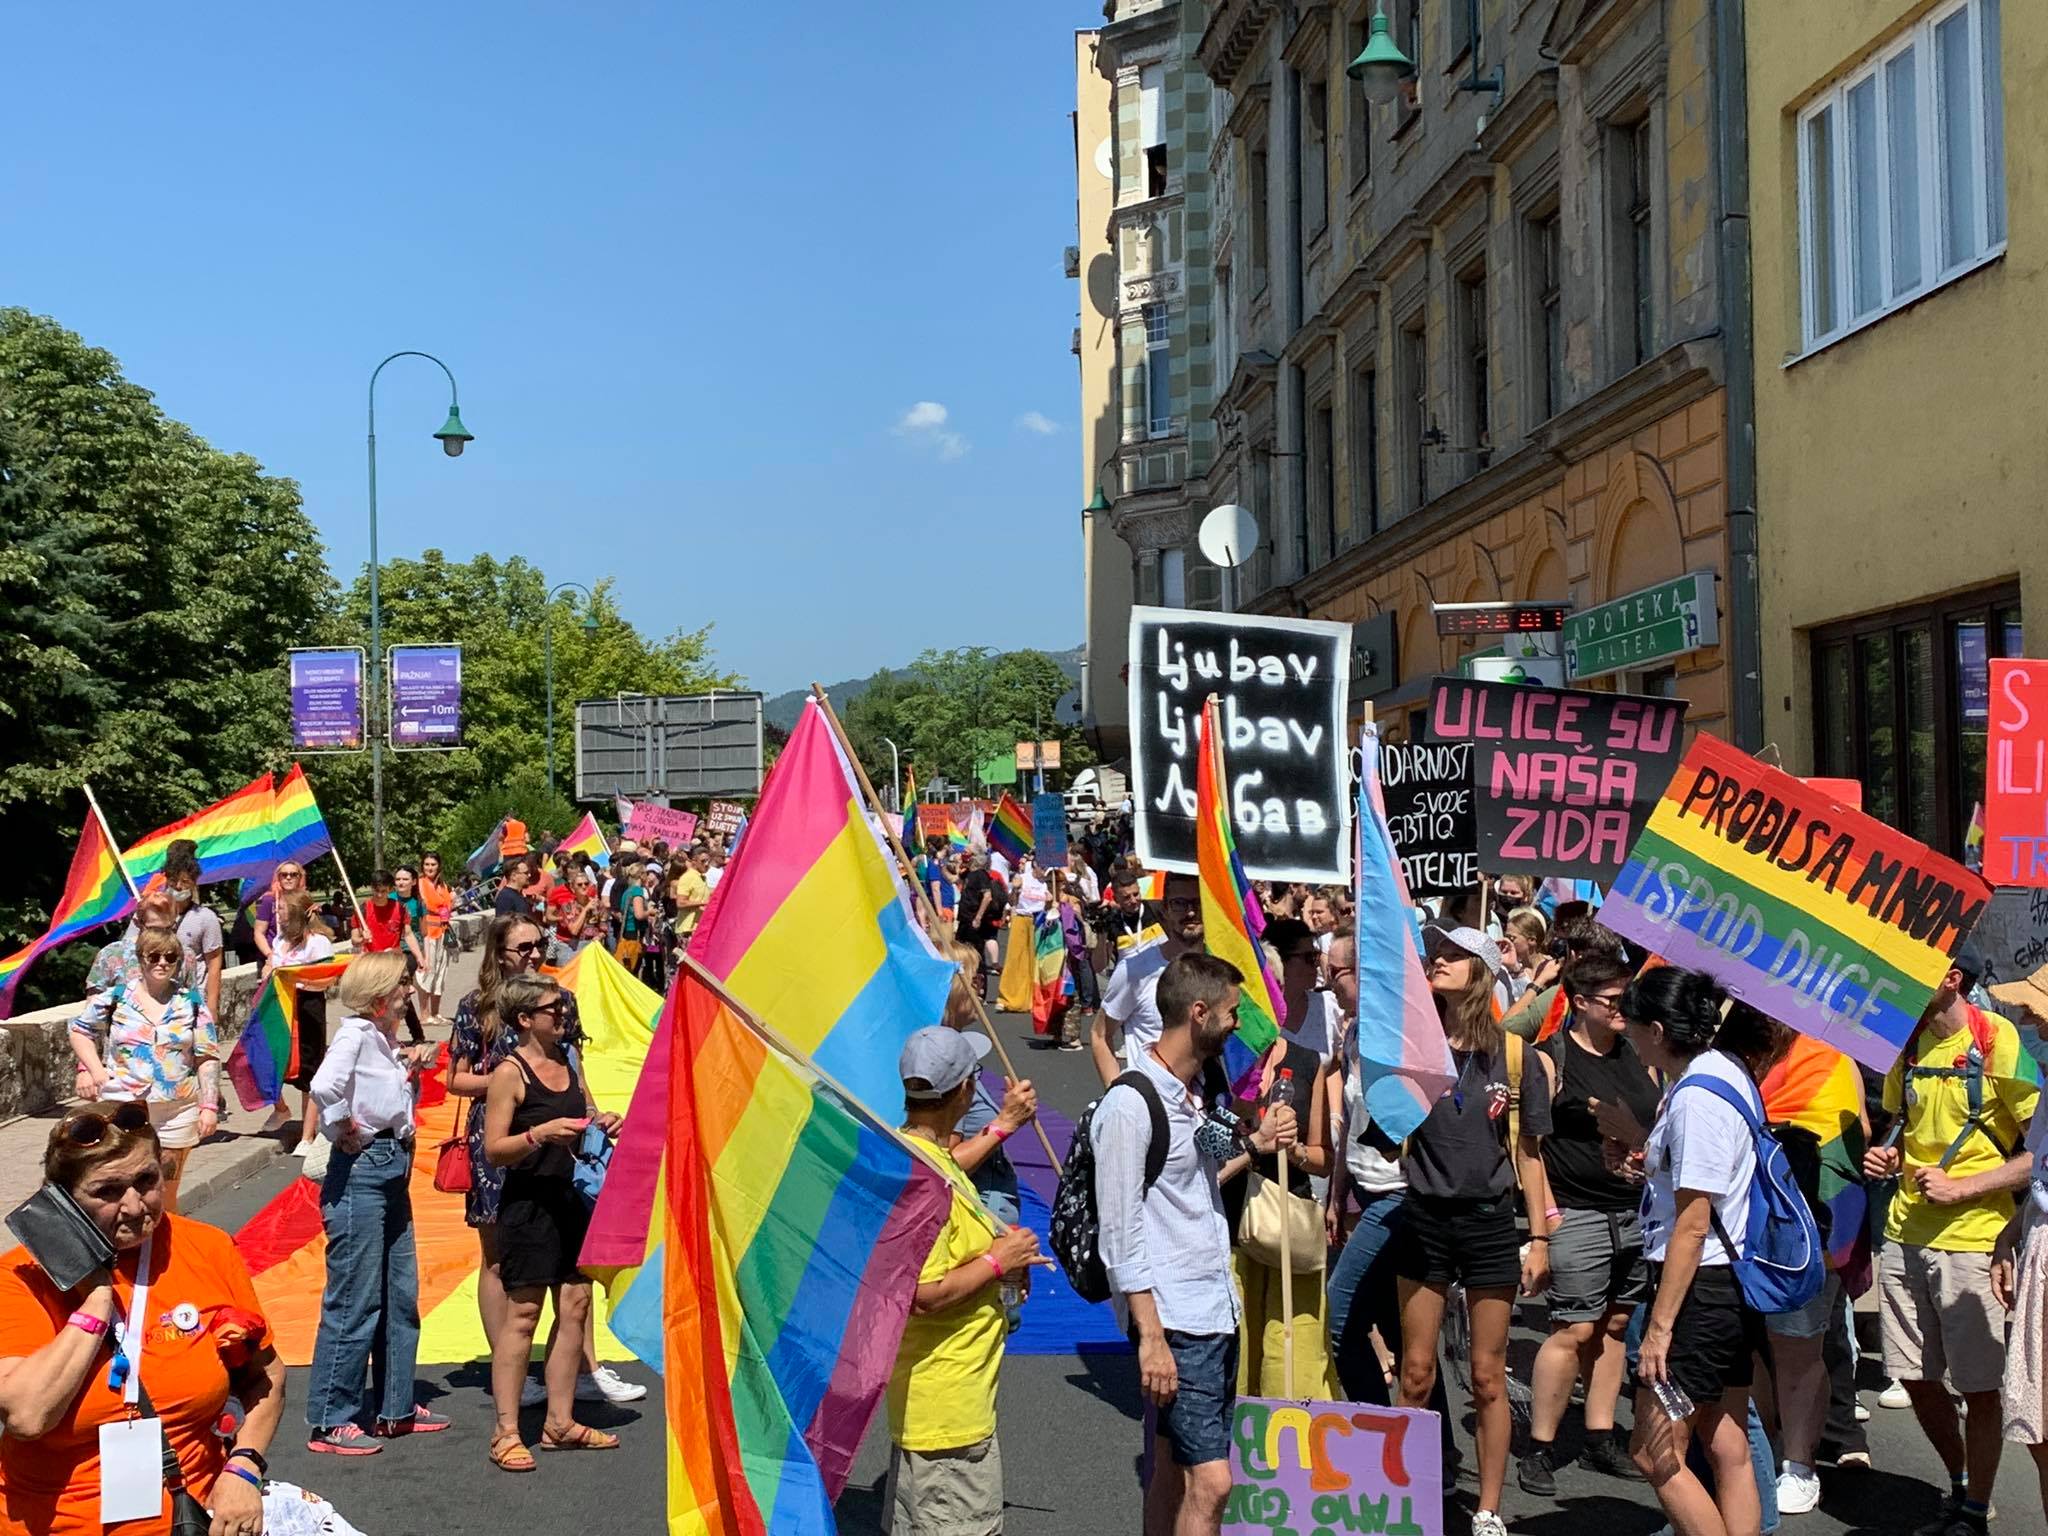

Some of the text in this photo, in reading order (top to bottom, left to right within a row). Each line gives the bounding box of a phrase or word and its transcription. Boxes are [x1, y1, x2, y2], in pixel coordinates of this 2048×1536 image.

[1573, 588, 1682, 643] APOTEKA
[1597, 631, 1657, 664] ALTEA
[1157, 627, 1318, 691] ljubav
[431, 704, 455, 715] 10m
[1157, 691, 1323, 757] ljbav
[1434, 686, 1677, 753] ULICE SU
[1349, 742, 1475, 788] OIDARNOST
[1491, 744, 1638, 808] NAŠA
[1386, 814, 1456, 847] GBTIQ
[1499, 806, 1631, 865] ZIDA
[1776, 819, 1856, 895] SA
[1846, 850, 1987, 960] MNOM
[1618, 855, 1904, 1041] ISPOD DUGE
[1233, 1402, 1411, 1493] LJUB
